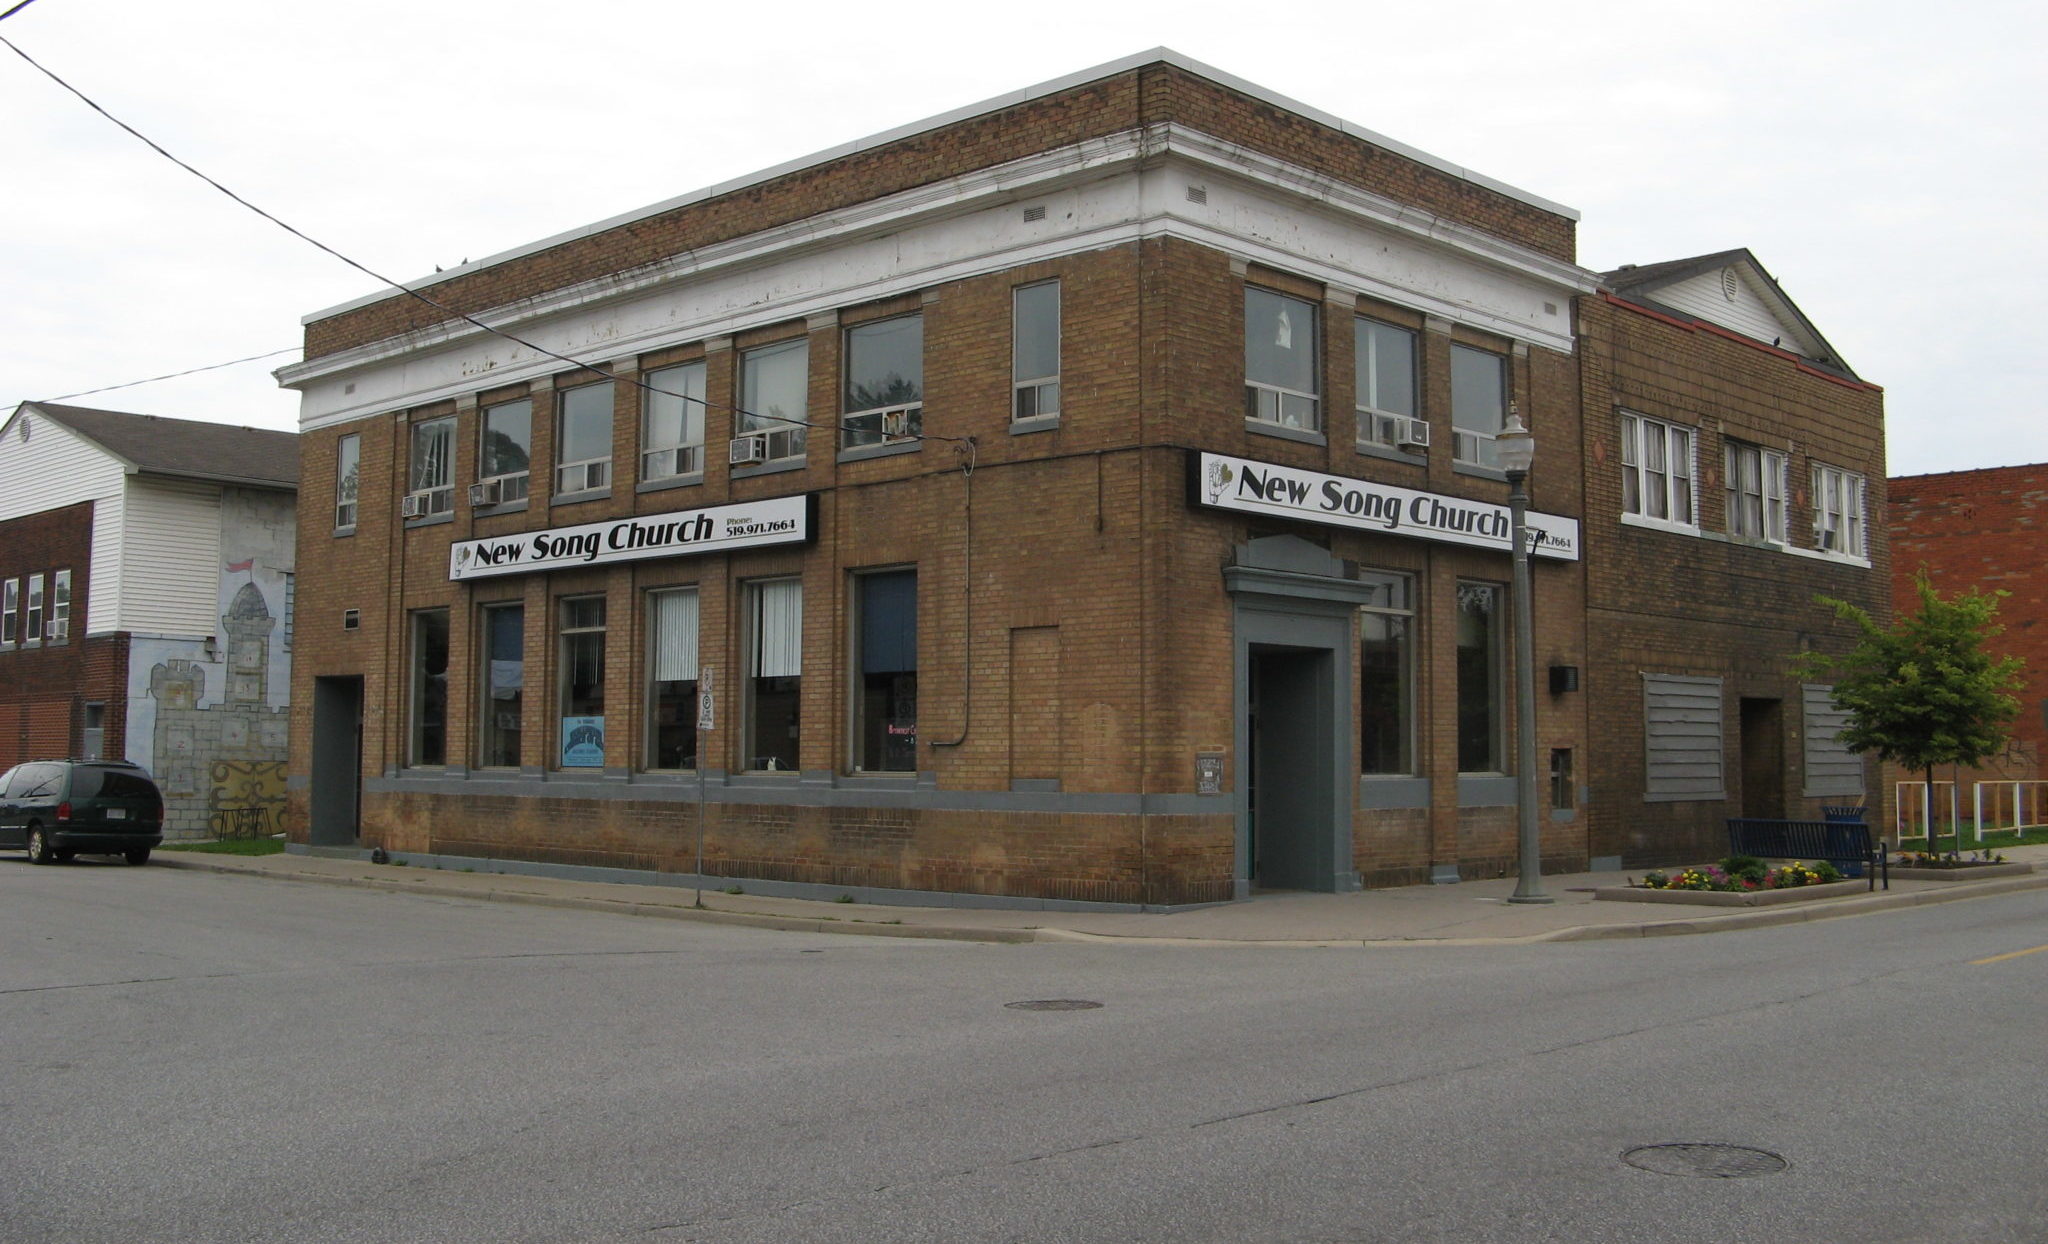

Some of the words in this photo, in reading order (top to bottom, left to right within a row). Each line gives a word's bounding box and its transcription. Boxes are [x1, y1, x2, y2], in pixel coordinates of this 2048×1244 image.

[1238, 465, 1312, 505] New
[1320, 480, 1402, 529] Song
[1409, 496, 1509, 538] Church
[726, 517, 752, 526] Phone:
[726, 519, 795, 537] 519.971.7664
[474, 541, 525, 567] New
[531, 534, 601, 561] Song
[608, 513, 714, 550] Church
